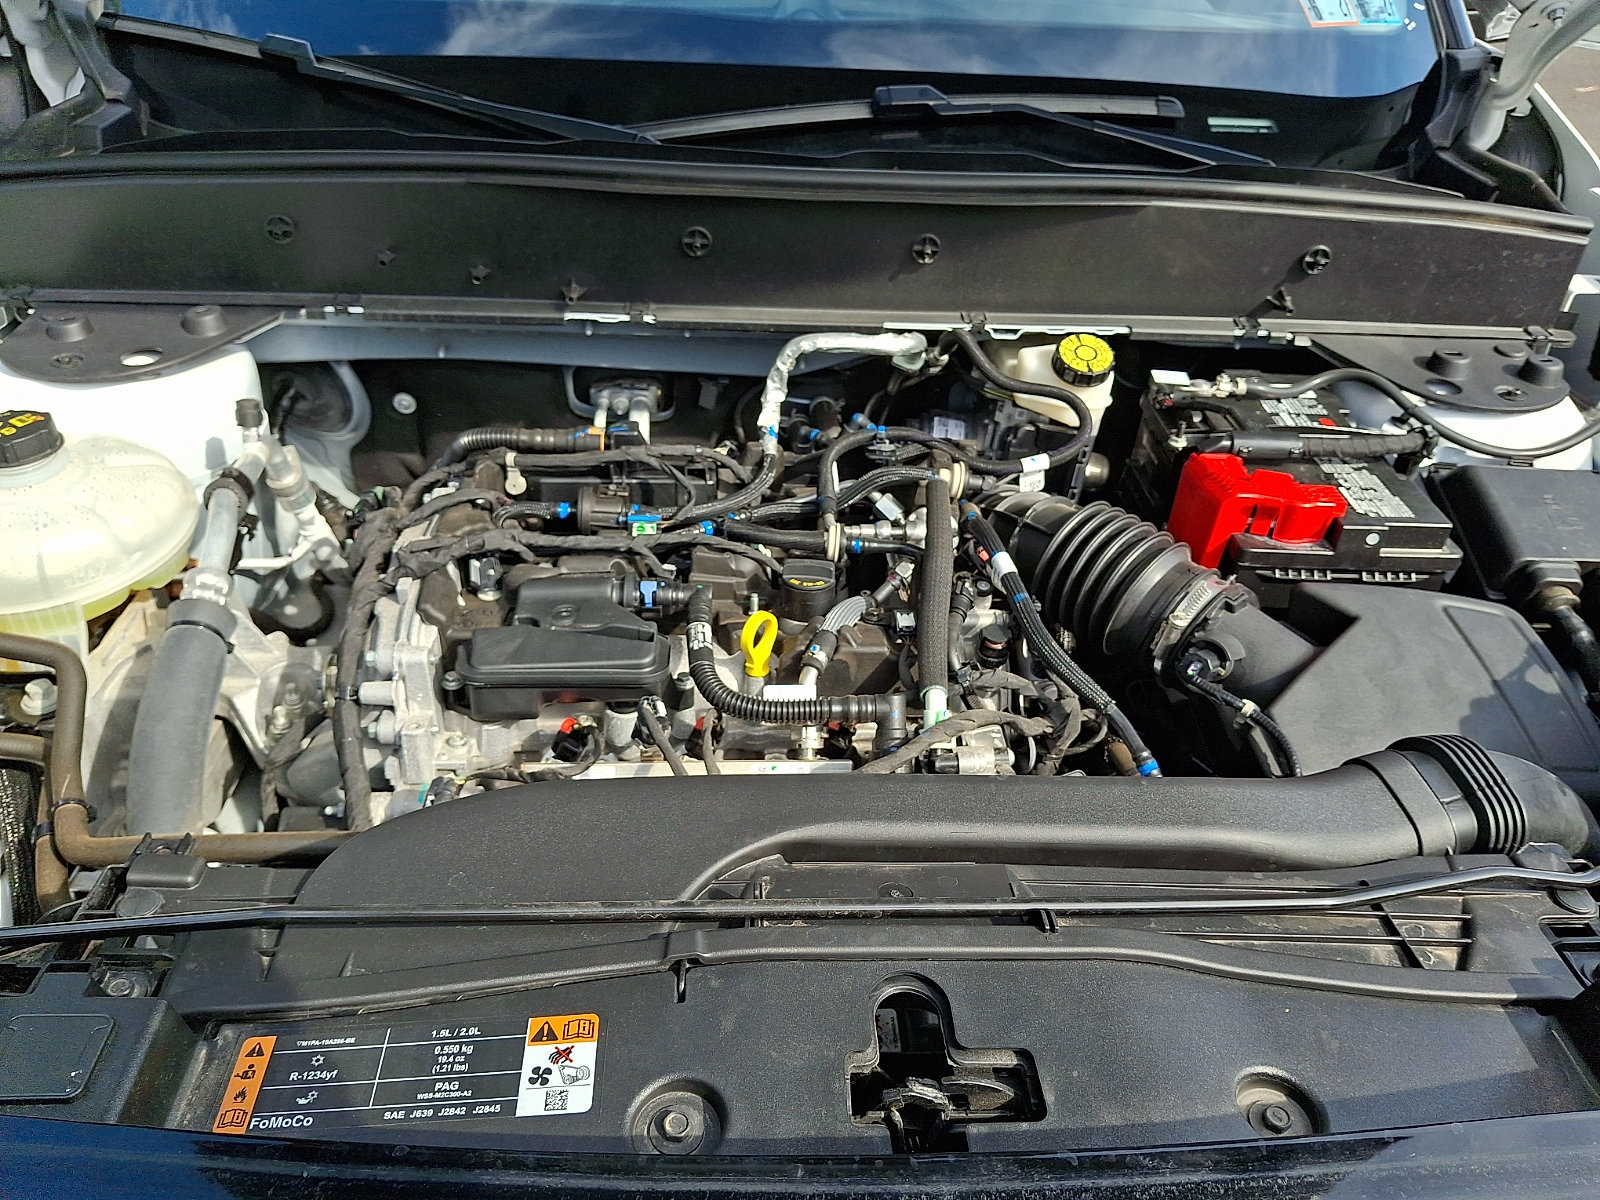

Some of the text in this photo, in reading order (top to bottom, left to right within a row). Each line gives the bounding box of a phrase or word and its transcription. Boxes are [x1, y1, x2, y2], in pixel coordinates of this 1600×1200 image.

[431, 1028, 452, 1038] 1.5L
[460, 1026, 481, 1036] 2.0L
[434, 1044, 473, 1055] 0.550 kg
[437, 1055, 454, 1063] 19.4
[432, 1063, 469, 1074] (1.21 lbs)
[289, 1069, 338, 1081] R-1234yf
[434, 1081, 460, 1091] PAG
[383, 1104, 501, 1120] SAE J639 J2842 J2845
[249, 1114, 314, 1130] FoMoCo
